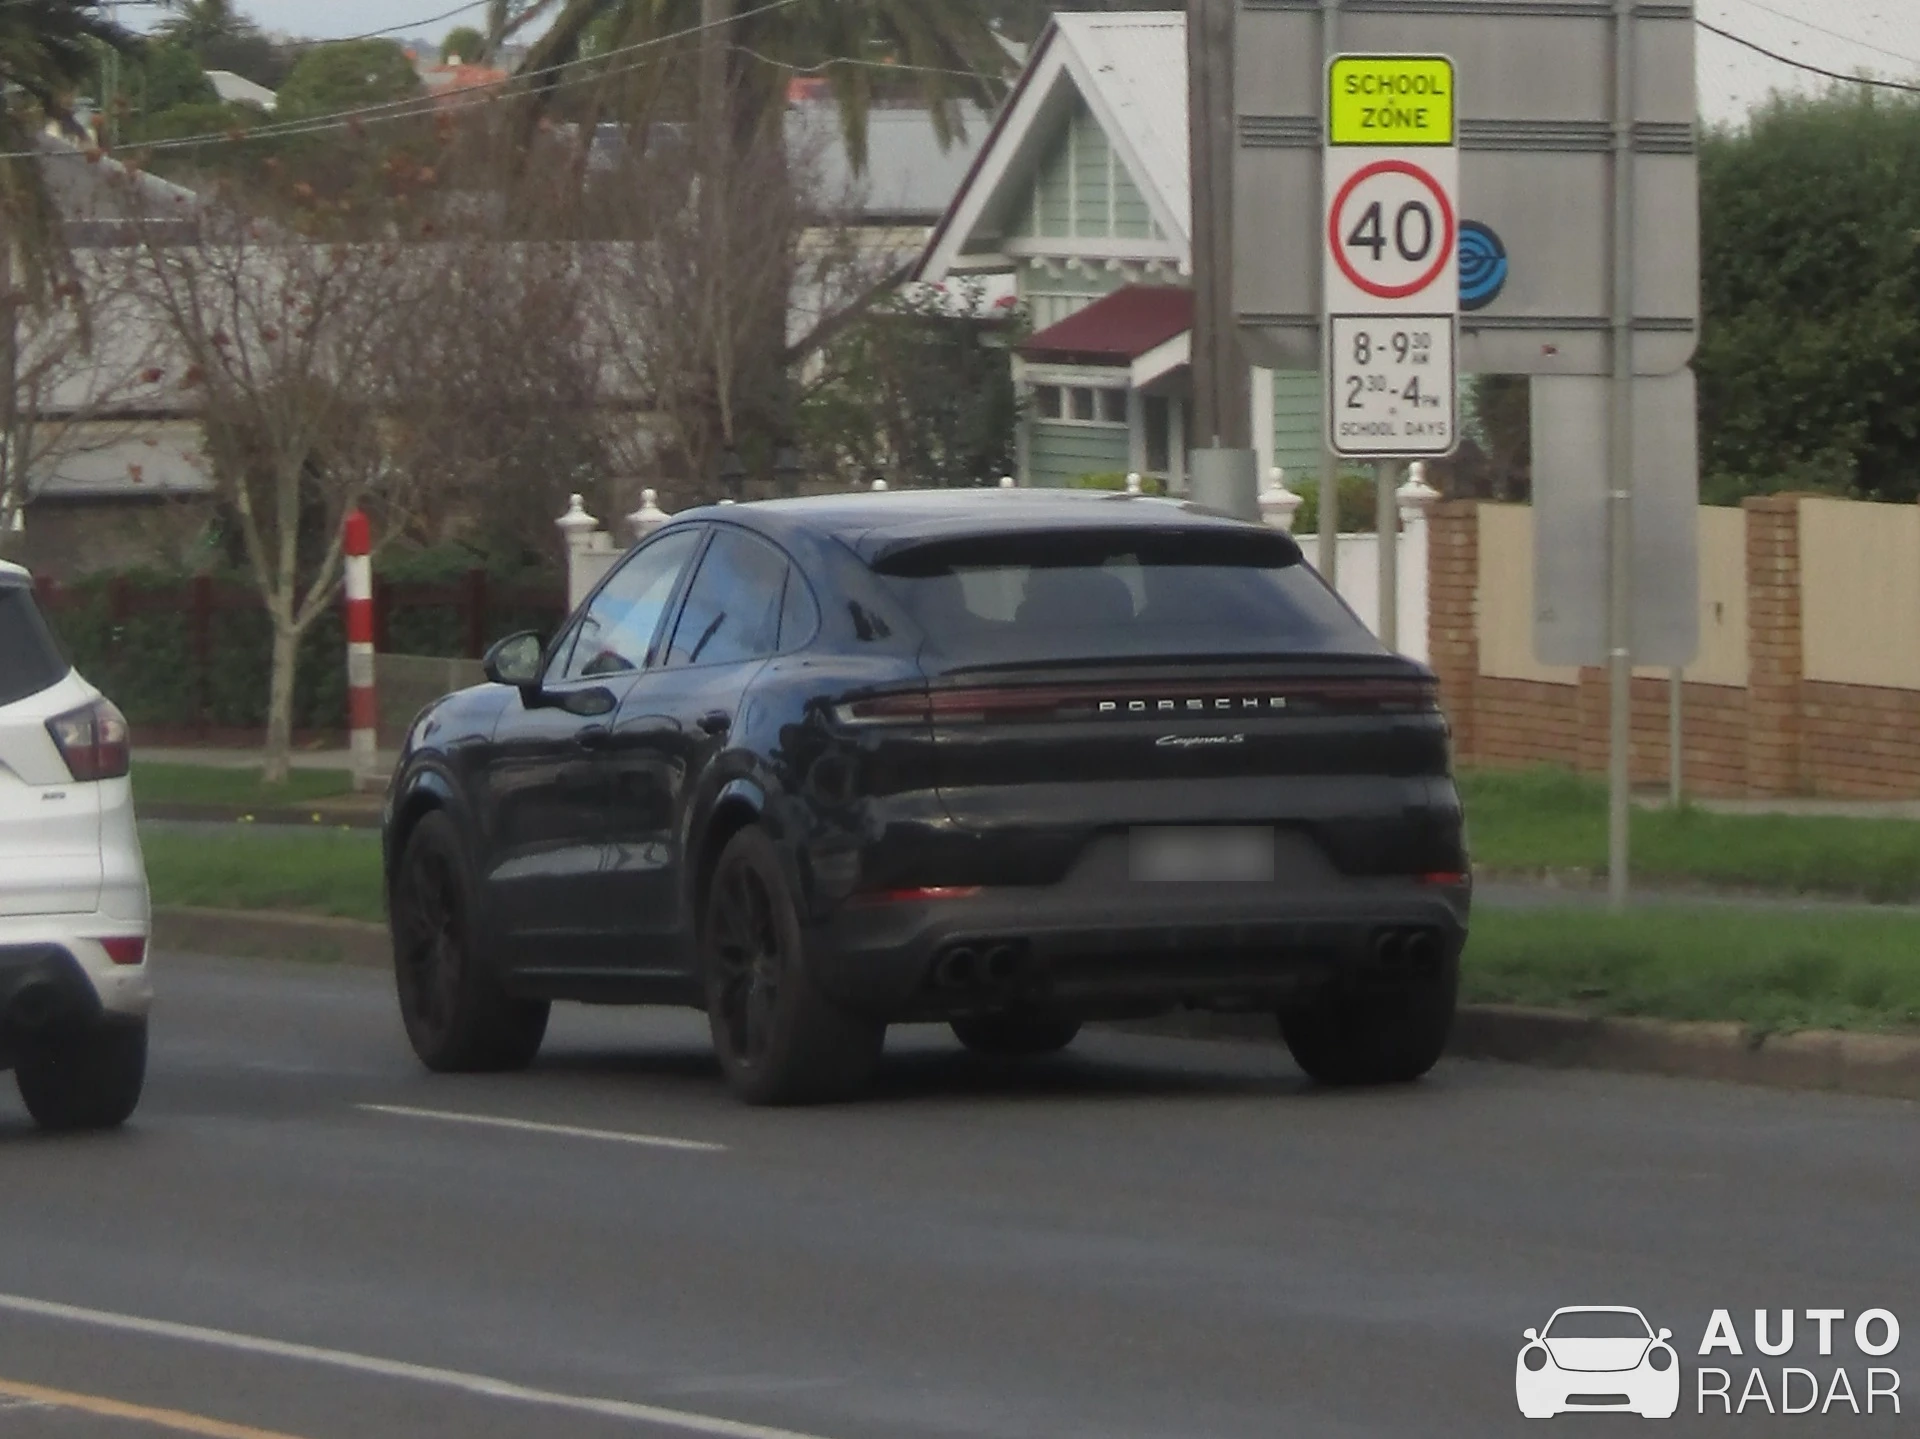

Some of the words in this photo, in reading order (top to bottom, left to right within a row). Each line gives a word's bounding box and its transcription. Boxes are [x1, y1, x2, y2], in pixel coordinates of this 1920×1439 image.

[1345, 74, 1444, 95] SCHOOL
[1362, 107, 1428, 128] ZONE
[1347, 200, 1432, 262] 40
[1340, 422, 1397, 436] SCHOOL
[1406, 422, 1446, 436] DAYS
[1099, 697, 1286, 712] PORSCHE
